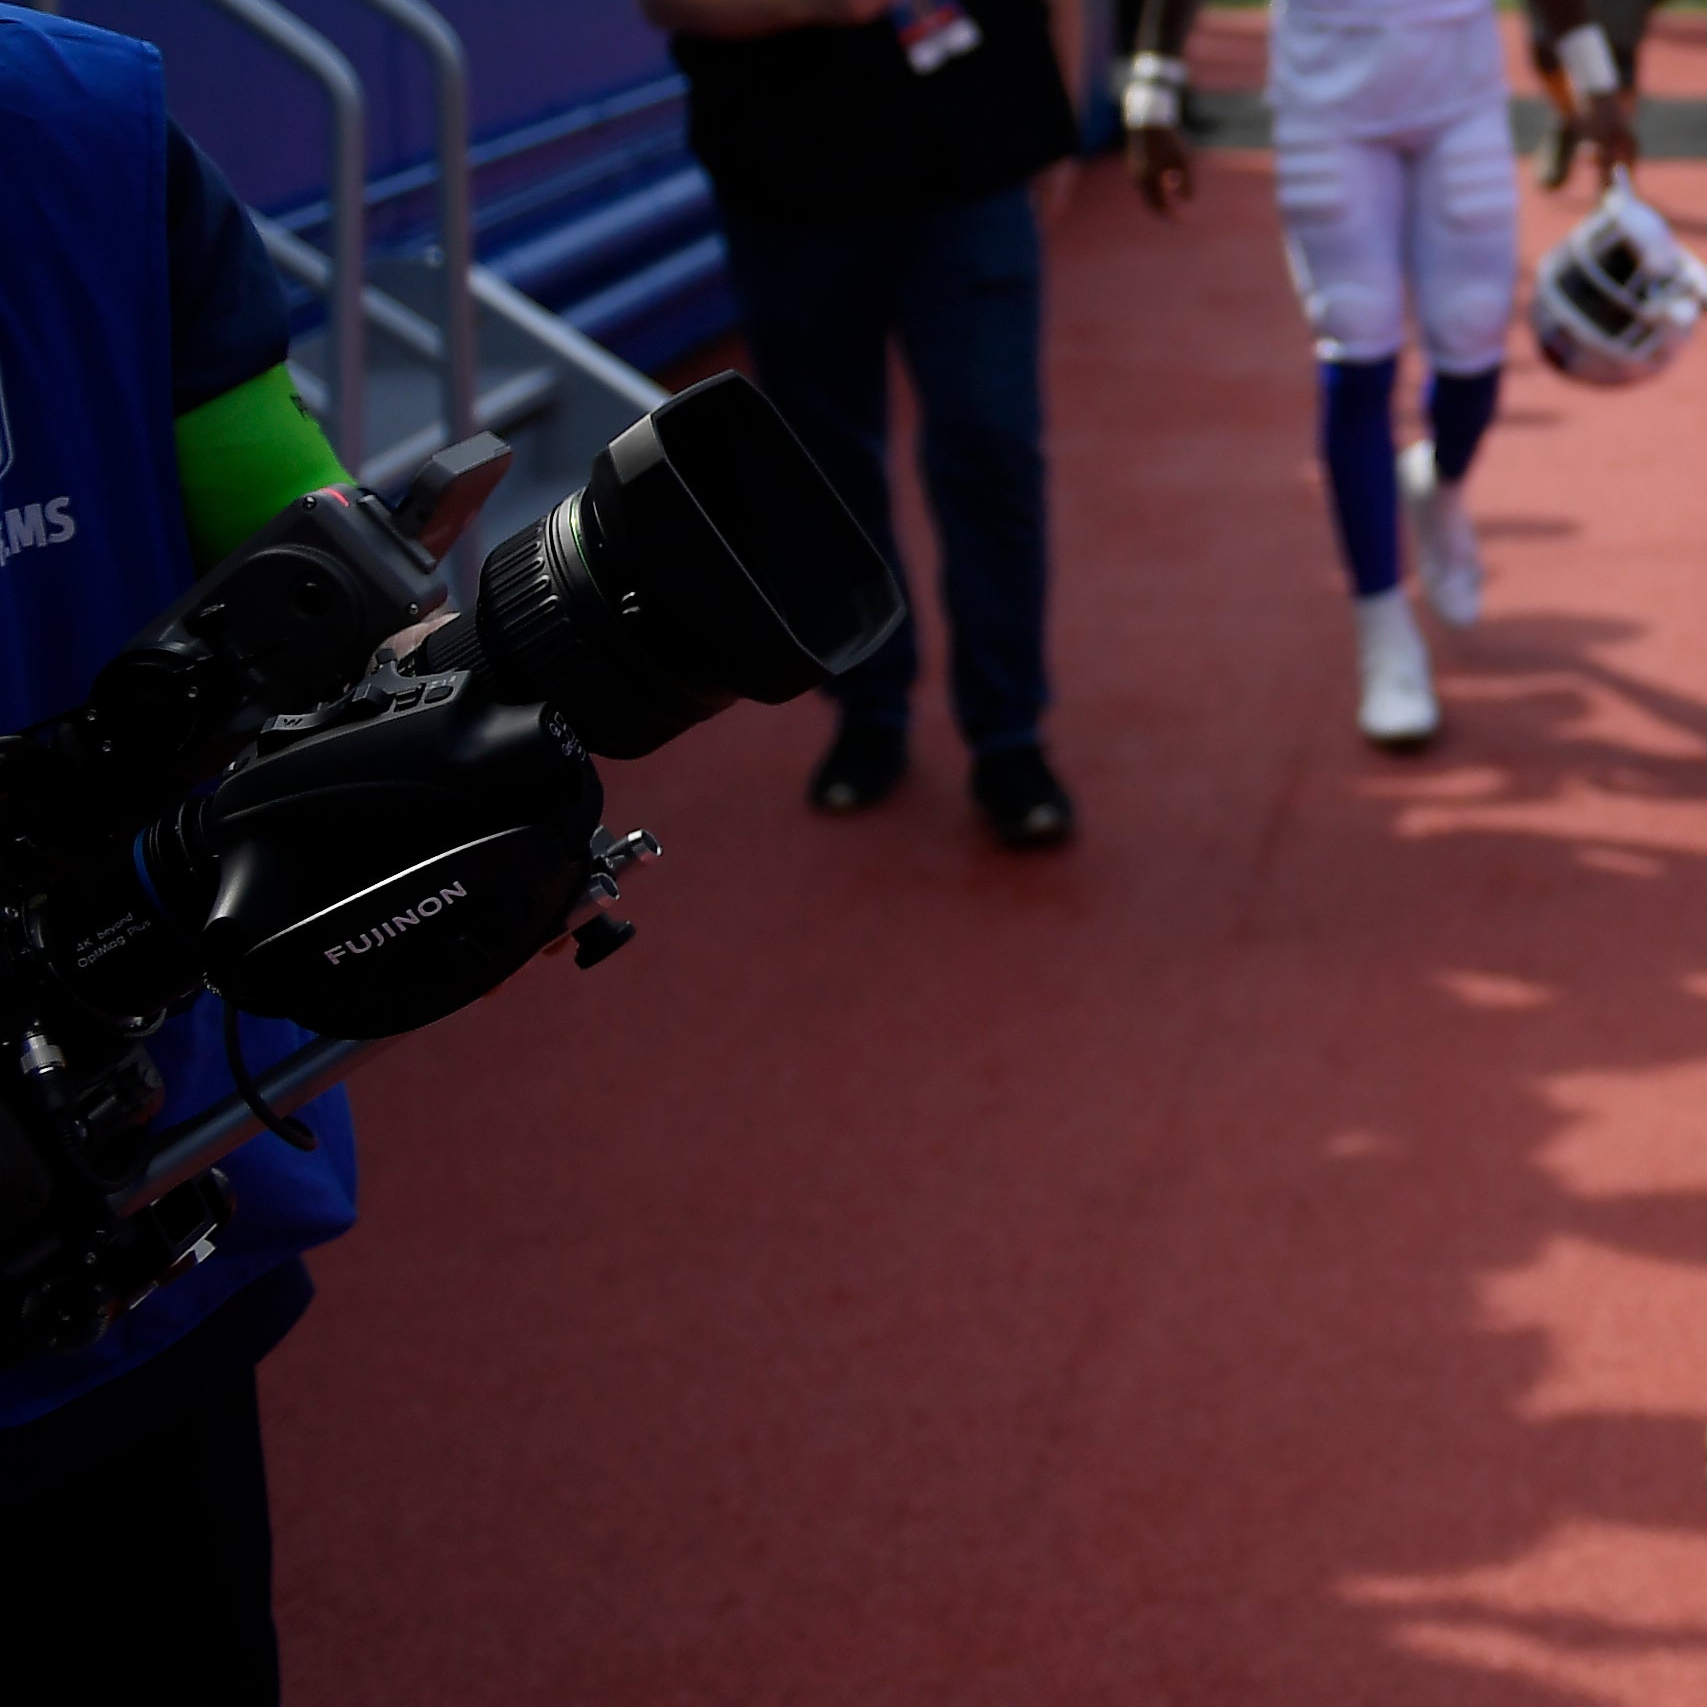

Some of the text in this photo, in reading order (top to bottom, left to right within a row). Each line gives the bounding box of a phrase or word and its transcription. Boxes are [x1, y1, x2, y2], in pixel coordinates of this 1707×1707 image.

[0, 496, 76, 567] MS
[76, 911, 134, 952] 4K beyond
[322, 879, 468, 966] FUJINON
